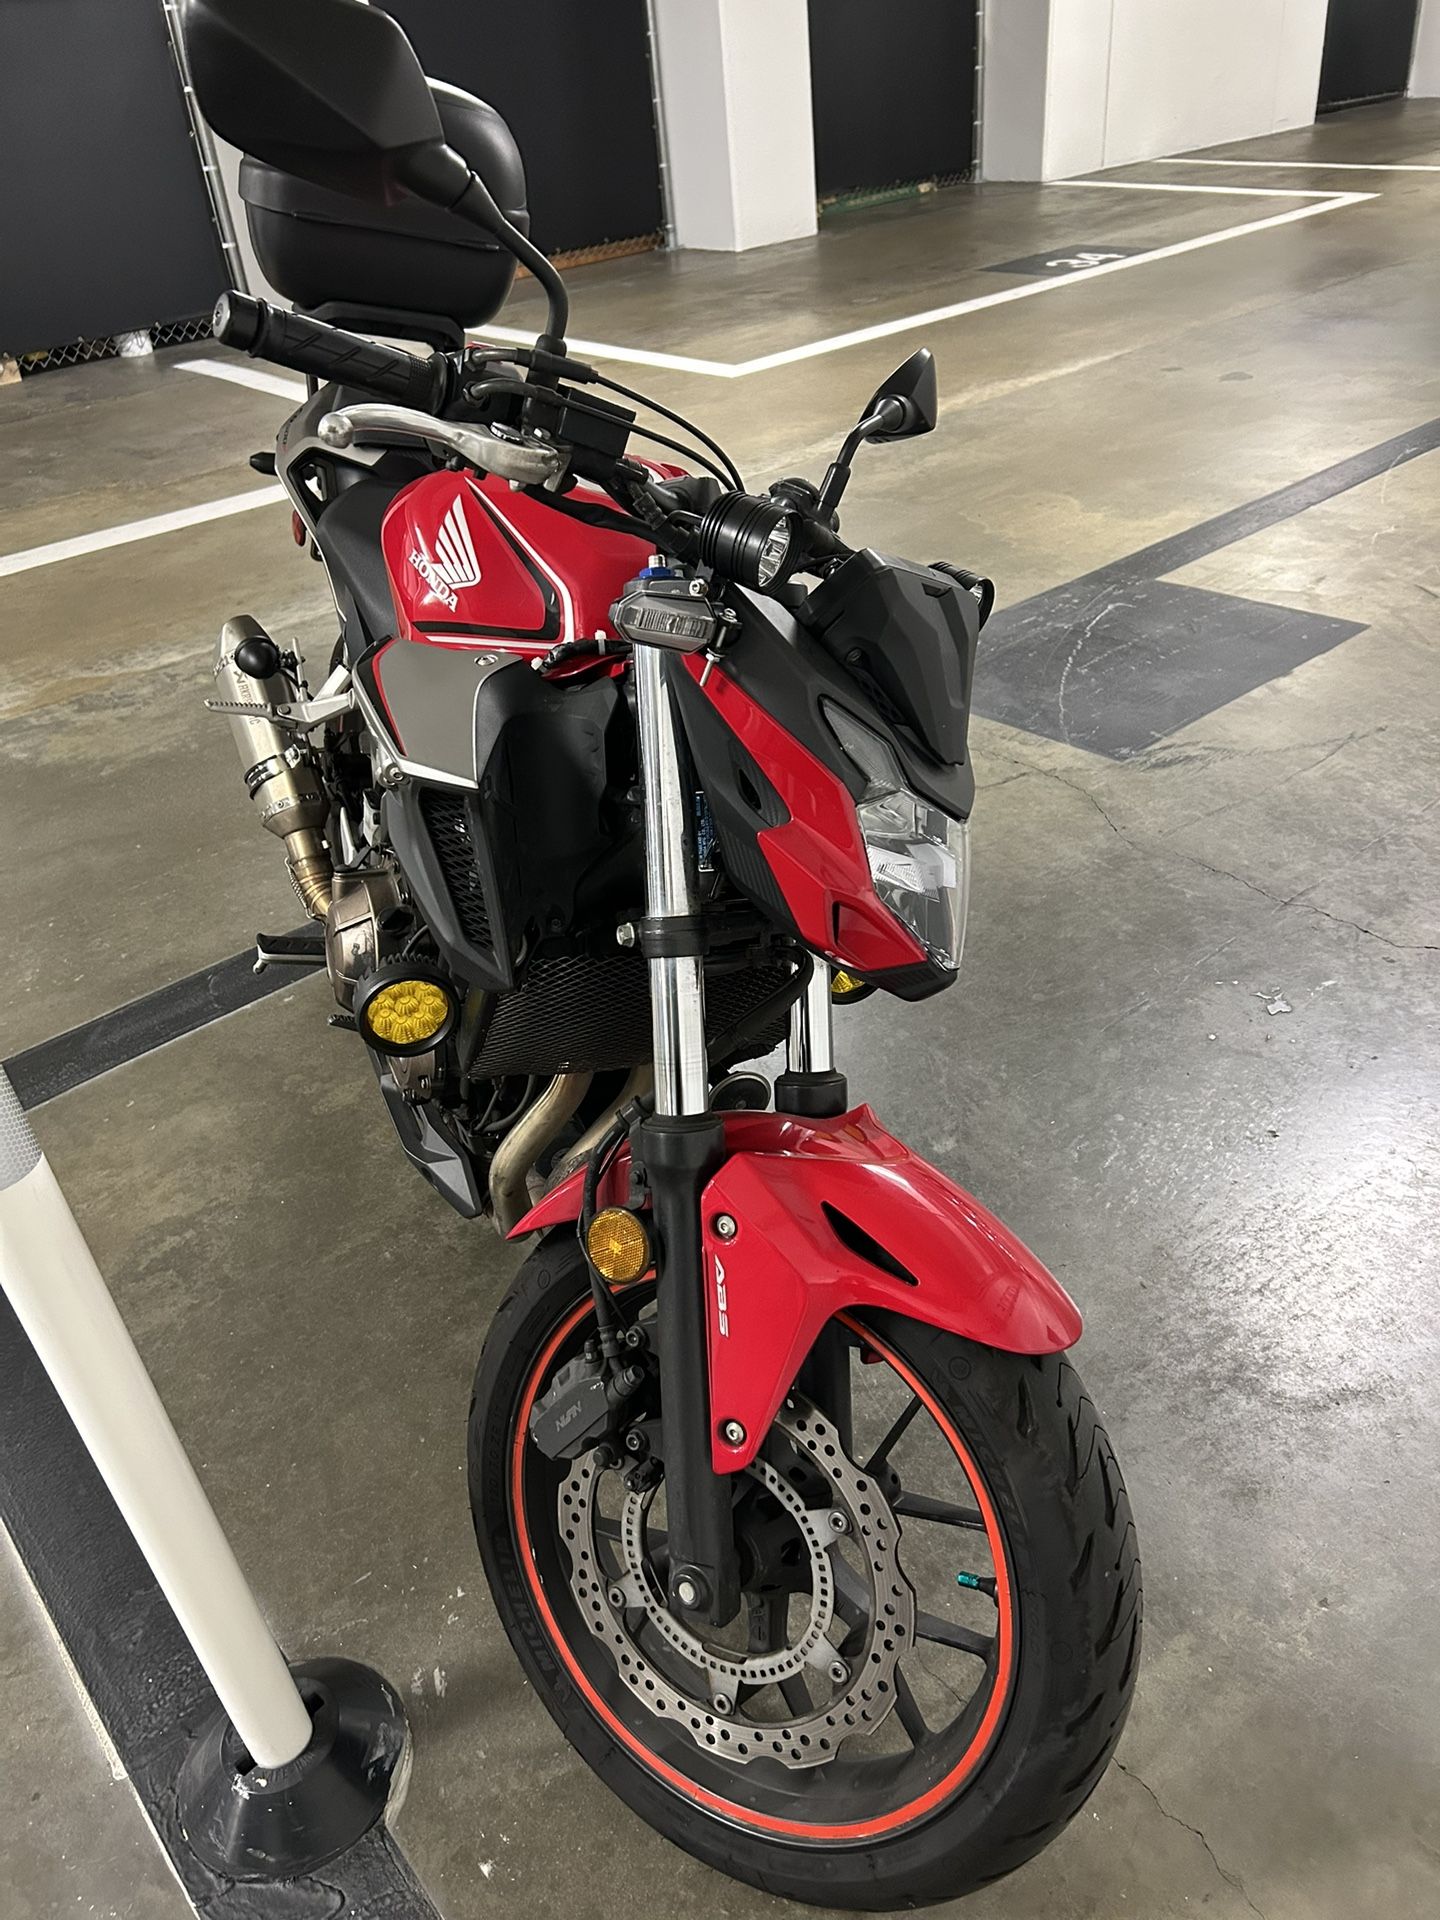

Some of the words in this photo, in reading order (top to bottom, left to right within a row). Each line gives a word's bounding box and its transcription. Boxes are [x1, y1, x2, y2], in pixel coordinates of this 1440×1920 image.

[1045, 253, 1126, 268] 34
[408, 550, 458, 612] HONDA
[714, 1254, 729, 1338] ABS
[493, 1533, 558, 1672] MICHELIN
